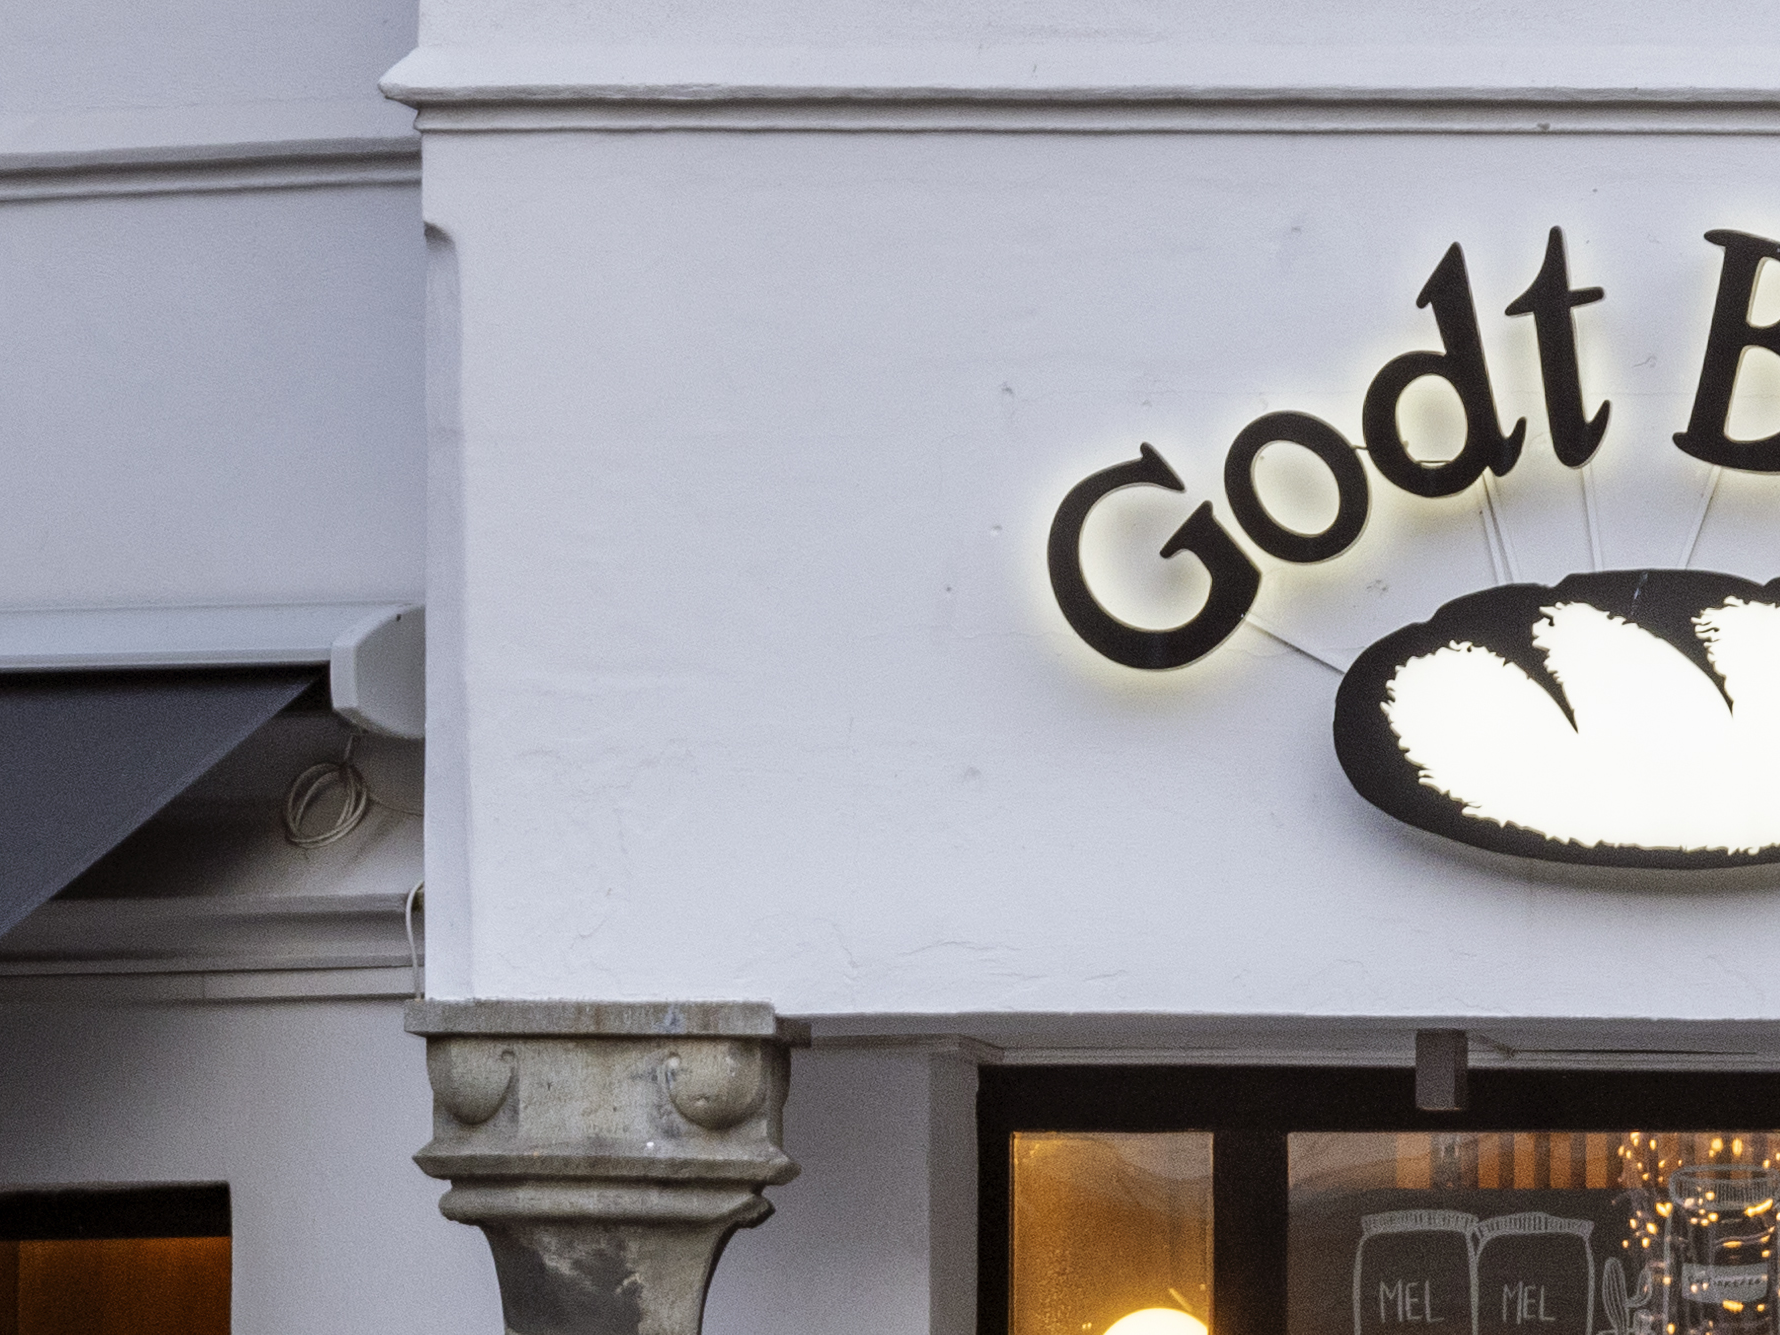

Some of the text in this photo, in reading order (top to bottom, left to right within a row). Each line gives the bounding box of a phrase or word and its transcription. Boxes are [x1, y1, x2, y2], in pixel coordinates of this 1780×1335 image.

[1047, 226, 1611, 671] Godt
[1379, 1278, 1445, 1323] MEL
[1502, 1281, 1556, 1325] MEL
